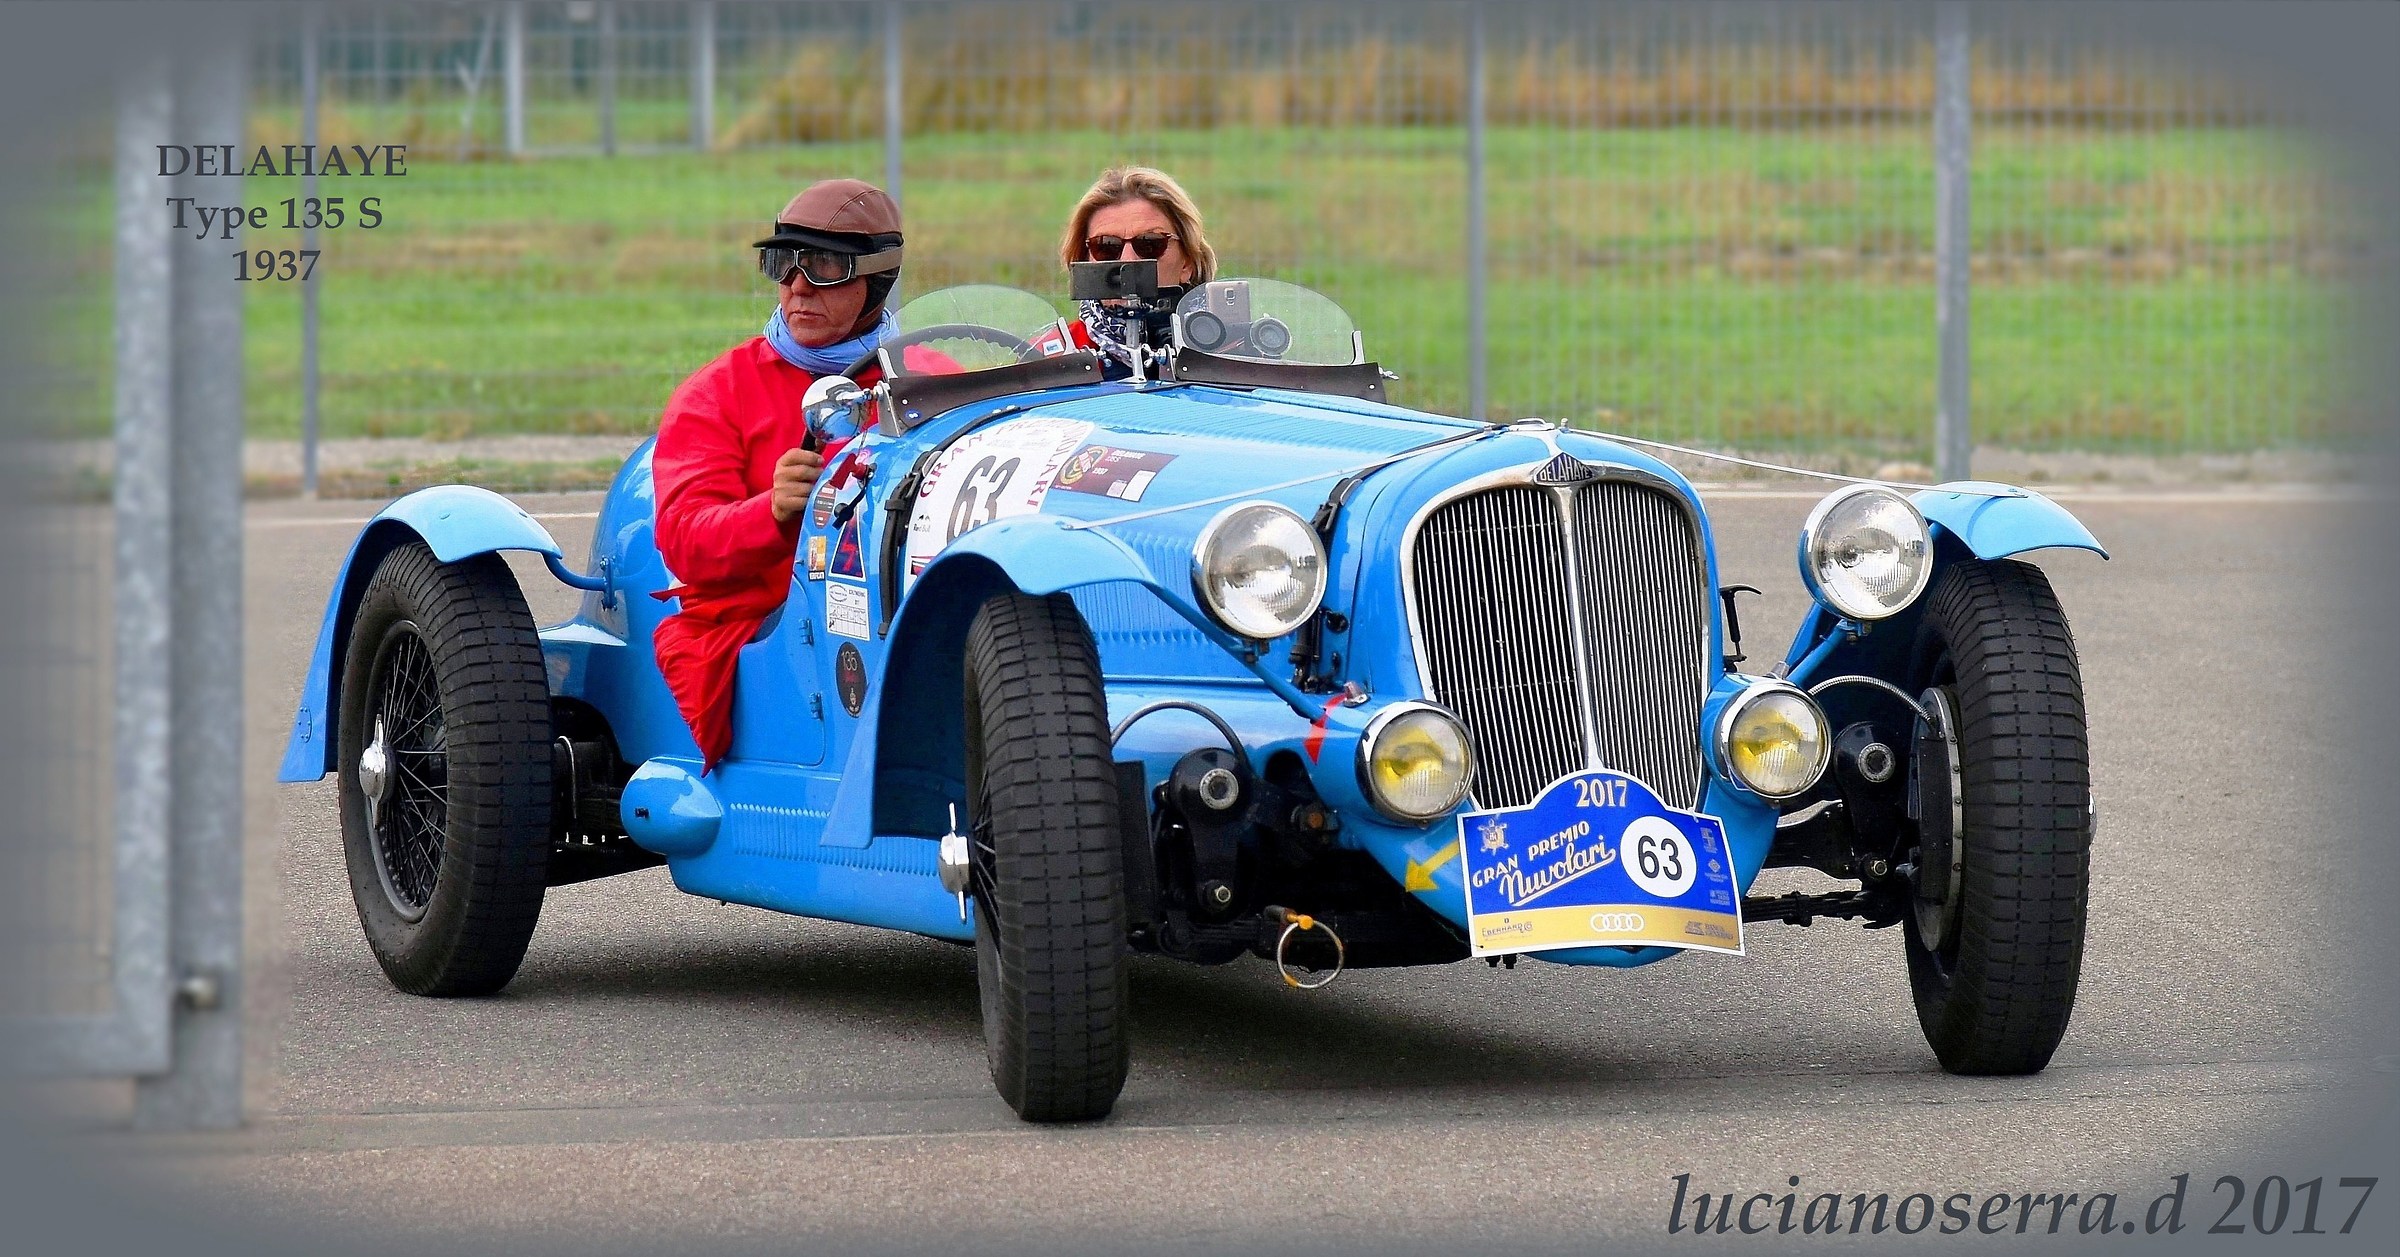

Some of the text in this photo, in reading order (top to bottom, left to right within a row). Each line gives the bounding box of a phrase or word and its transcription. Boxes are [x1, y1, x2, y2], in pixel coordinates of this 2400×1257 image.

[1540, 453, 1590, 482] DELAHAYE
[946, 455, 1022, 547] 63
[841, 651, 858, 671] 135
[1573, 778, 1628, 808] 2017
[1472, 821, 1590, 888] GRAN PREMIO
[1499, 834, 1616, 905] Nuvolari
[1637, 835, 1683, 882] 63
